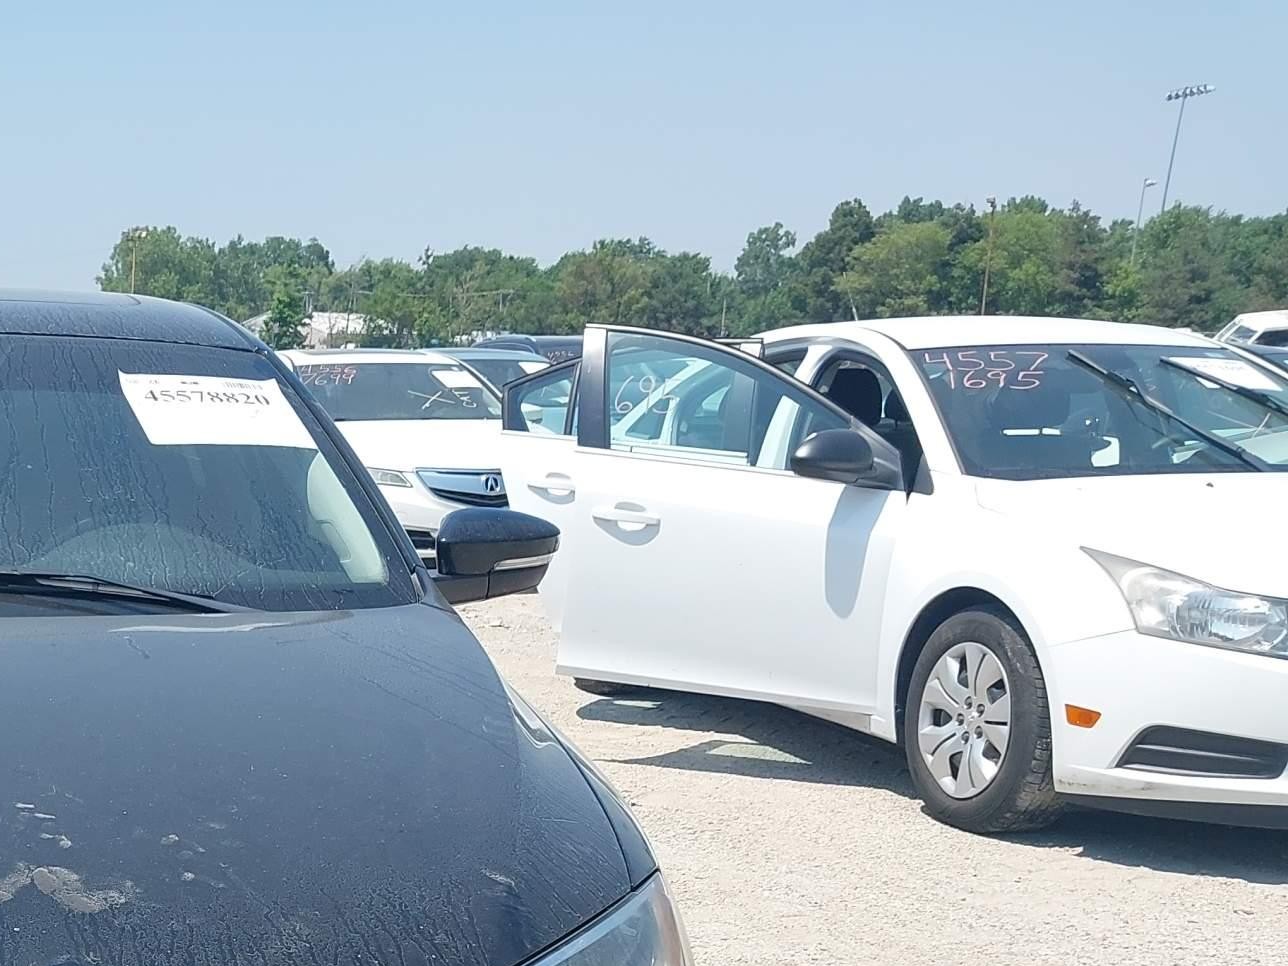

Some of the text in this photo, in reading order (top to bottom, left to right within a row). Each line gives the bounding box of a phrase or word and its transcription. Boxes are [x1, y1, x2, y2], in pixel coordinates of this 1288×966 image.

[923, 351, 1048, 371] 4557
[949, 370, 1044, 390] 1695
[144, 389, 271, 406] 45578820
